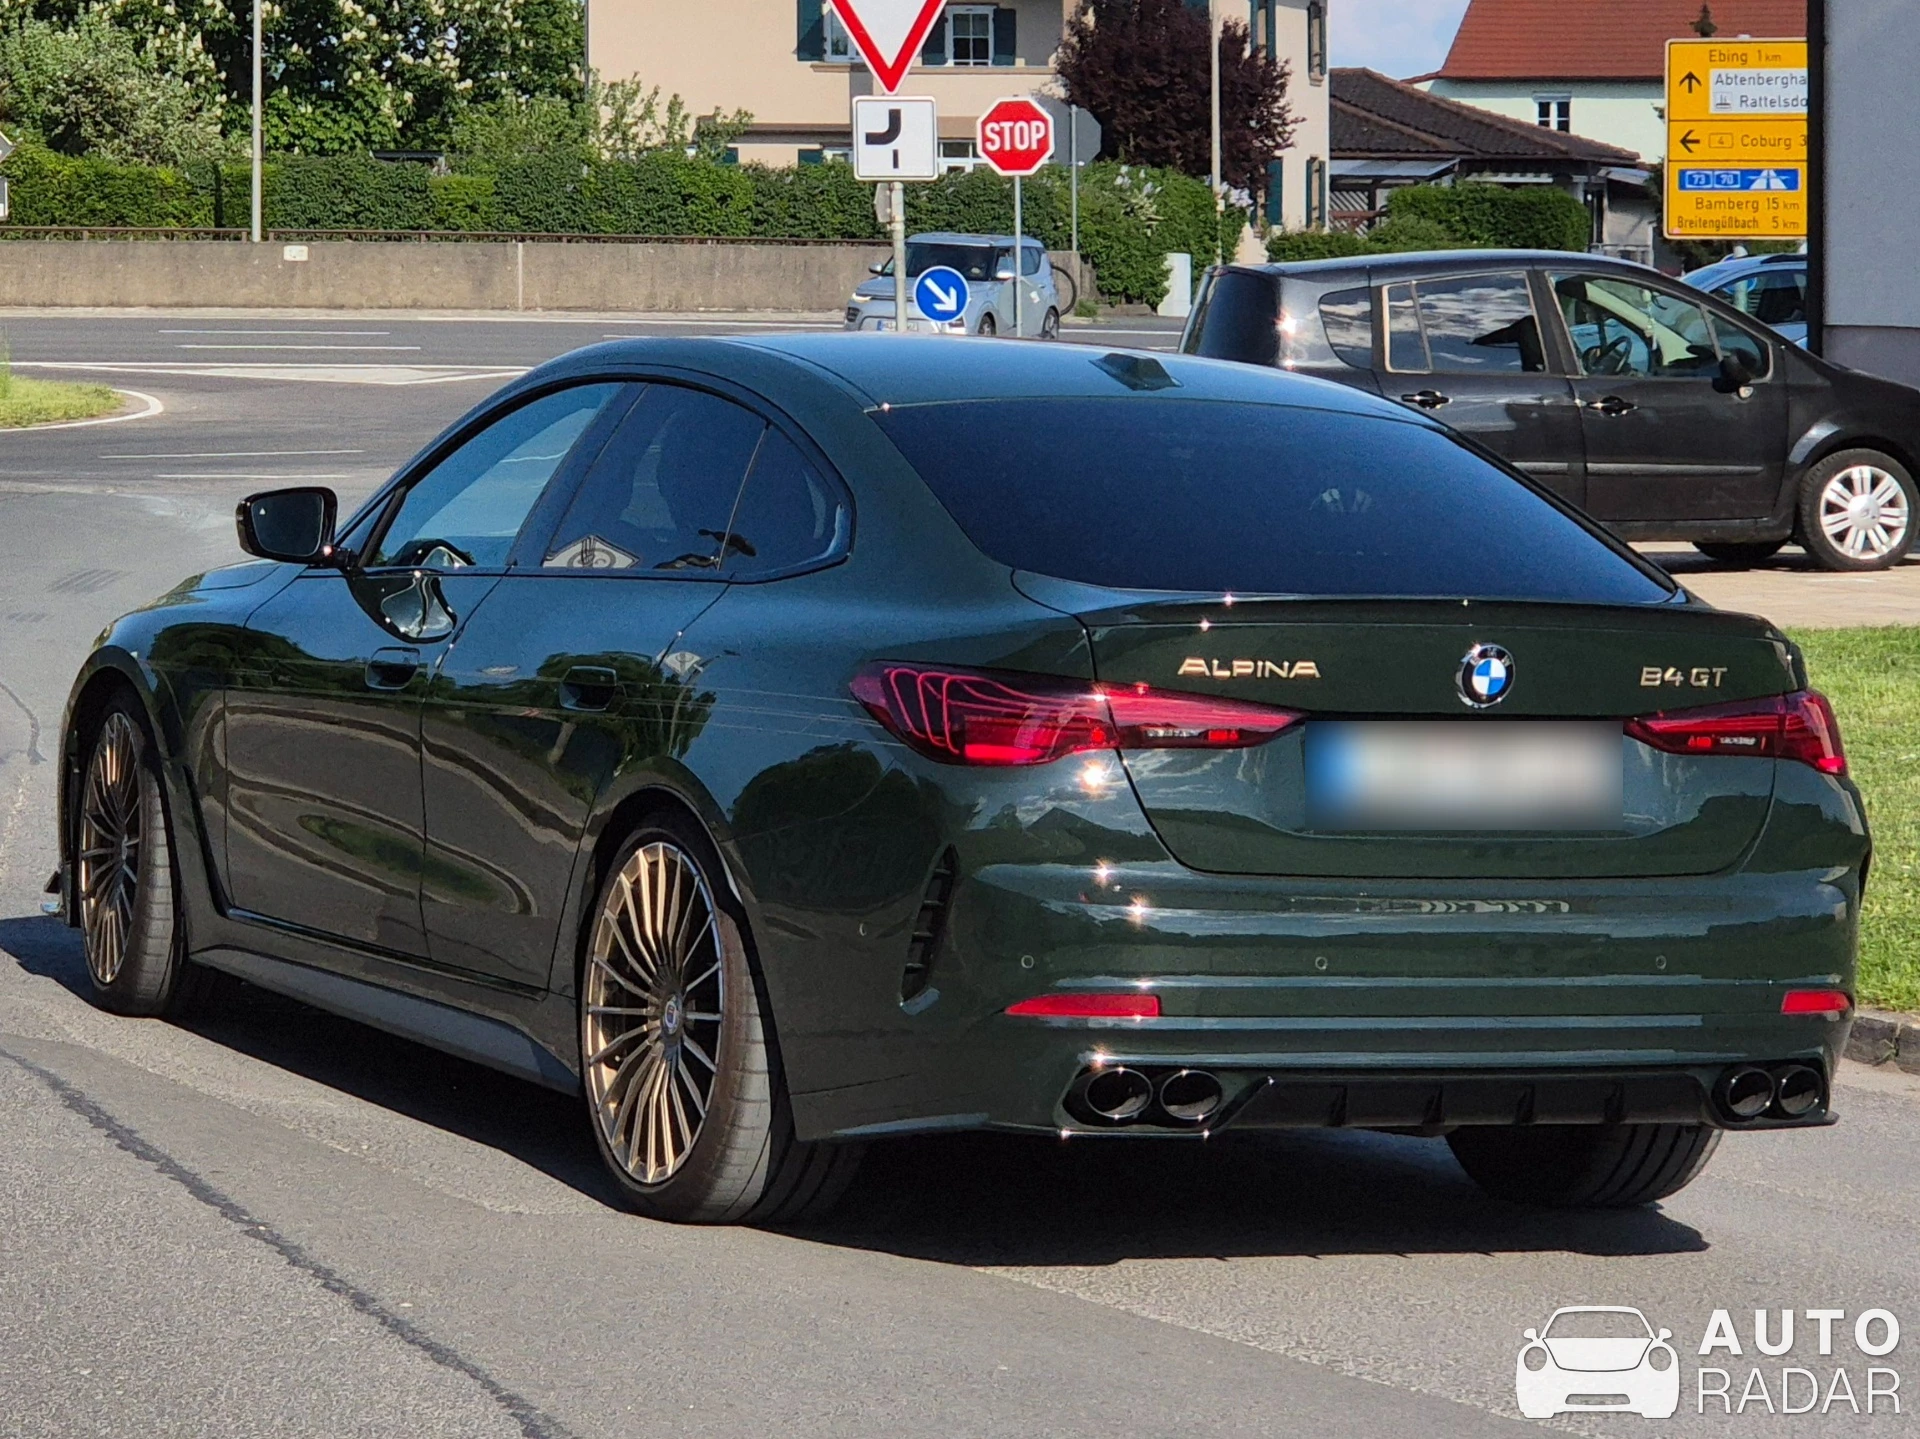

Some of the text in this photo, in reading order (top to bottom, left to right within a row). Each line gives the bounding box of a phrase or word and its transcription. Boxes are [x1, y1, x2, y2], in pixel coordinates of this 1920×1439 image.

[1709, 49, 1781, 65] Ebing 1 km
[1715, 73, 1807, 89] Abtenbergha
[1740, 95, 1808, 108] Rattelsdo
[985, 121, 1046, 151] STOP
[1741, 134, 1792, 151] Coburg
[1692, 174, 1734, 185] 73 70
[1695, 197, 1799, 213] Bamberg 15 km
[1677, 215, 1799, 232] Breitengüßbach 5 km
[1177, 657, 1321, 679] ALPINA
[1640, 666, 1728, 687] B4 GT
